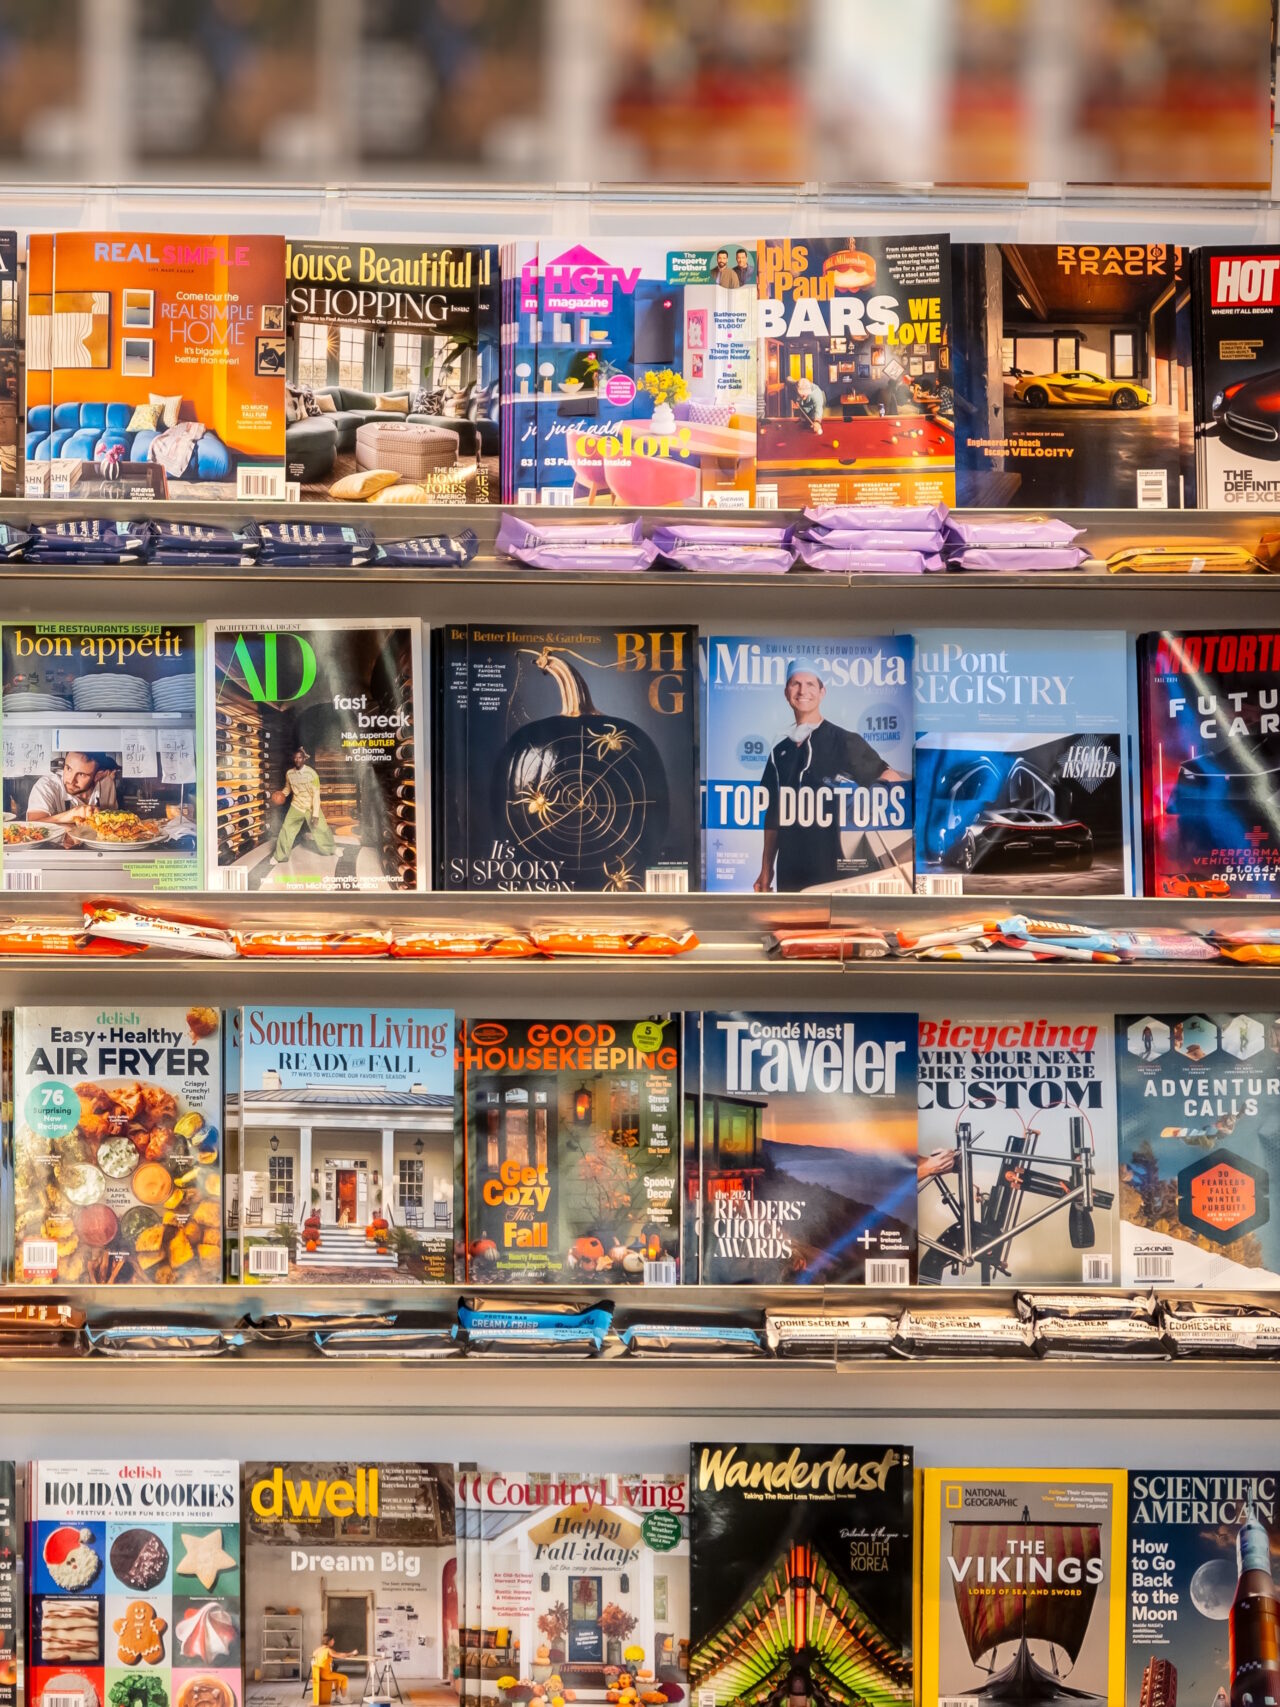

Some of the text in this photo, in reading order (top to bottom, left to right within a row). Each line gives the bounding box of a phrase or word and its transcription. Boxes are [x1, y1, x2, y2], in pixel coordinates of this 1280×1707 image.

[94, 243, 250, 266] REAL SIMPLE
[1058, 246, 1144, 260] ROAD
[359, 246, 472, 288] Beautiful
[1057, 260, 1166, 275] TRACK
[545, 267, 642, 295] HGTV
[1217, 260, 1280, 302] HOT
[291, 287, 448, 320] SHOPPING
[549, 298, 608, 309] magazine
[908, 298, 941, 320] WE
[757, 295, 900, 338] BARS
[887, 323, 941, 345] LOVE
[576, 427, 691, 457] color!
[59, 625, 129, 633] RESTAURANTS
[473, 631, 601, 644] Better Homes & Gardens
[15, 629, 182, 665] bon appétit
[218, 632, 316, 702] AD
[334, 694, 367, 710] fast
[358, 712, 409, 728] break
[1067, 745, 1111, 762] LEGACY
[1062, 761, 1116, 779] INSPIRED
[715, 785, 905, 827] TOP DOCTORS
[473, 860, 565, 885] SPOOKY
[97, 1012, 140, 1026] delish
[250, 1011, 448, 1058] Southern Living
[528, 1024, 615, 1047] GOOD
[750, 1022, 842, 1039] Condé Nast
[919, 1020, 1098, 1054] Bicycling
[25, 1048, 210, 1076] AIR FRYER
[467, 1048, 677, 1070] HOUSEKEEPING
[717, 1021, 906, 1094] Traveler
[41, 1089, 64, 1105] 76
[500, 1161, 548, 1186] Get
[483, 1180, 551, 1211] Cozy
[714, 1201, 806, 1221] READERS'
[504, 1222, 548, 1248] Fall
[714, 1219, 783, 1239] CHOICE
[714, 1239, 793, 1259] AWARDS
[118, 1466, 162, 1479] delish
[699, 1447, 900, 1492] Wanderlust
[45, 1482, 234, 1508] HOLIDAY COOKIES
[251, 1467, 379, 1519] dwell
[965, 1489, 1007, 1497] NATIONAL
[1133, 1476, 1275, 1500] SCIENTIFIC
[965, 1498, 1018, 1507] GEOGRAPHIC
[1132, 1501, 1274, 1524] AMERICAN
[850, 1541, 889, 1557] SOUTH
[1007, 1540, 1045, 1555] THE
[1132, 1539, 1168, 1554] How
[291, 1551, 420, 1577] Dream Big
[851, 1557, 888, 1572] KOREA
[947, 1556, 1104, 1584] VIKINGS
[1132, 1557, 1175, 1571] to Go
[1132, 1573, 1173, 1588] Back
[1132, 1590, 1179, 1604] to the
[1132, 1607, 1177, 1621] Moon
